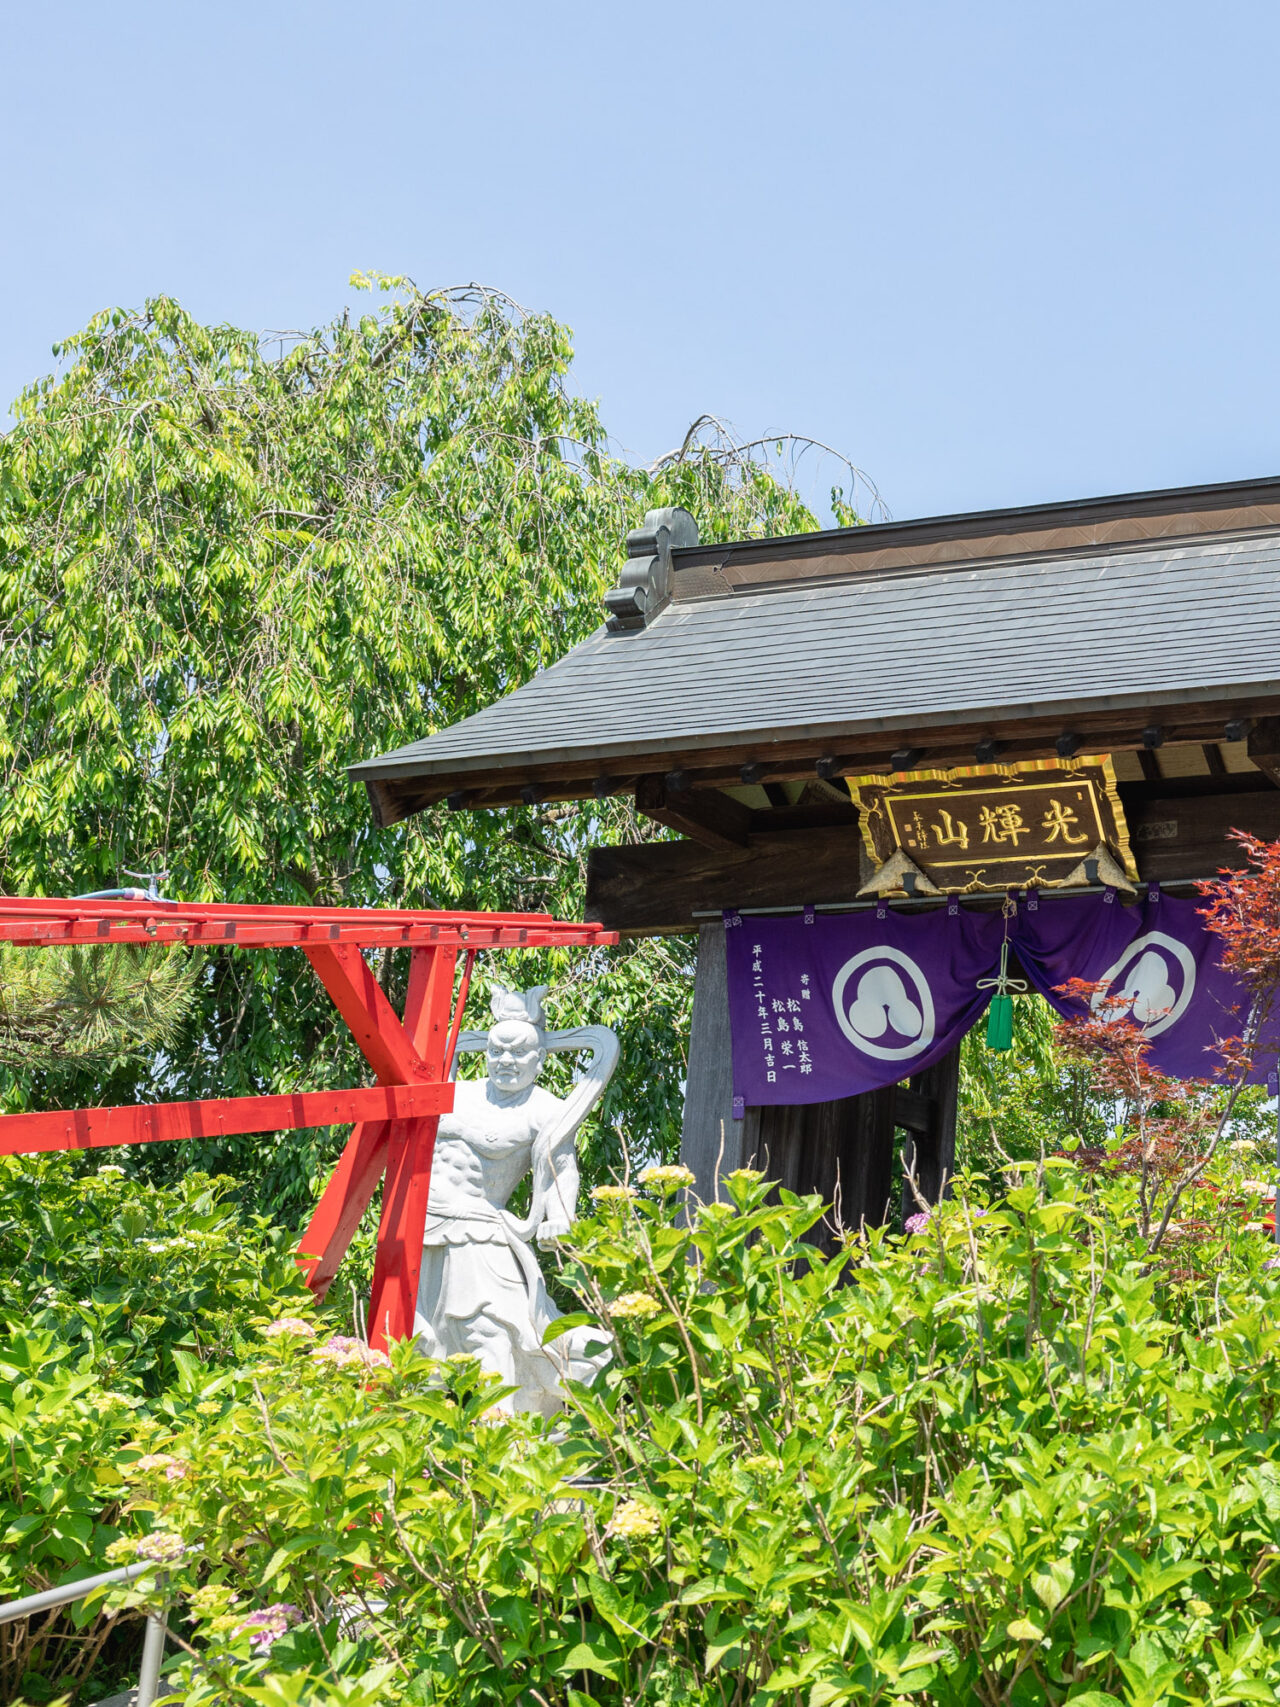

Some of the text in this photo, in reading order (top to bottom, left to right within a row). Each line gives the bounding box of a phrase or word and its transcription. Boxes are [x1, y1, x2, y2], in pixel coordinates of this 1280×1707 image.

[930, 798, 1089, 850] 光輝山
[752, 944, 778, 1083] 平成二十年三月吉日
